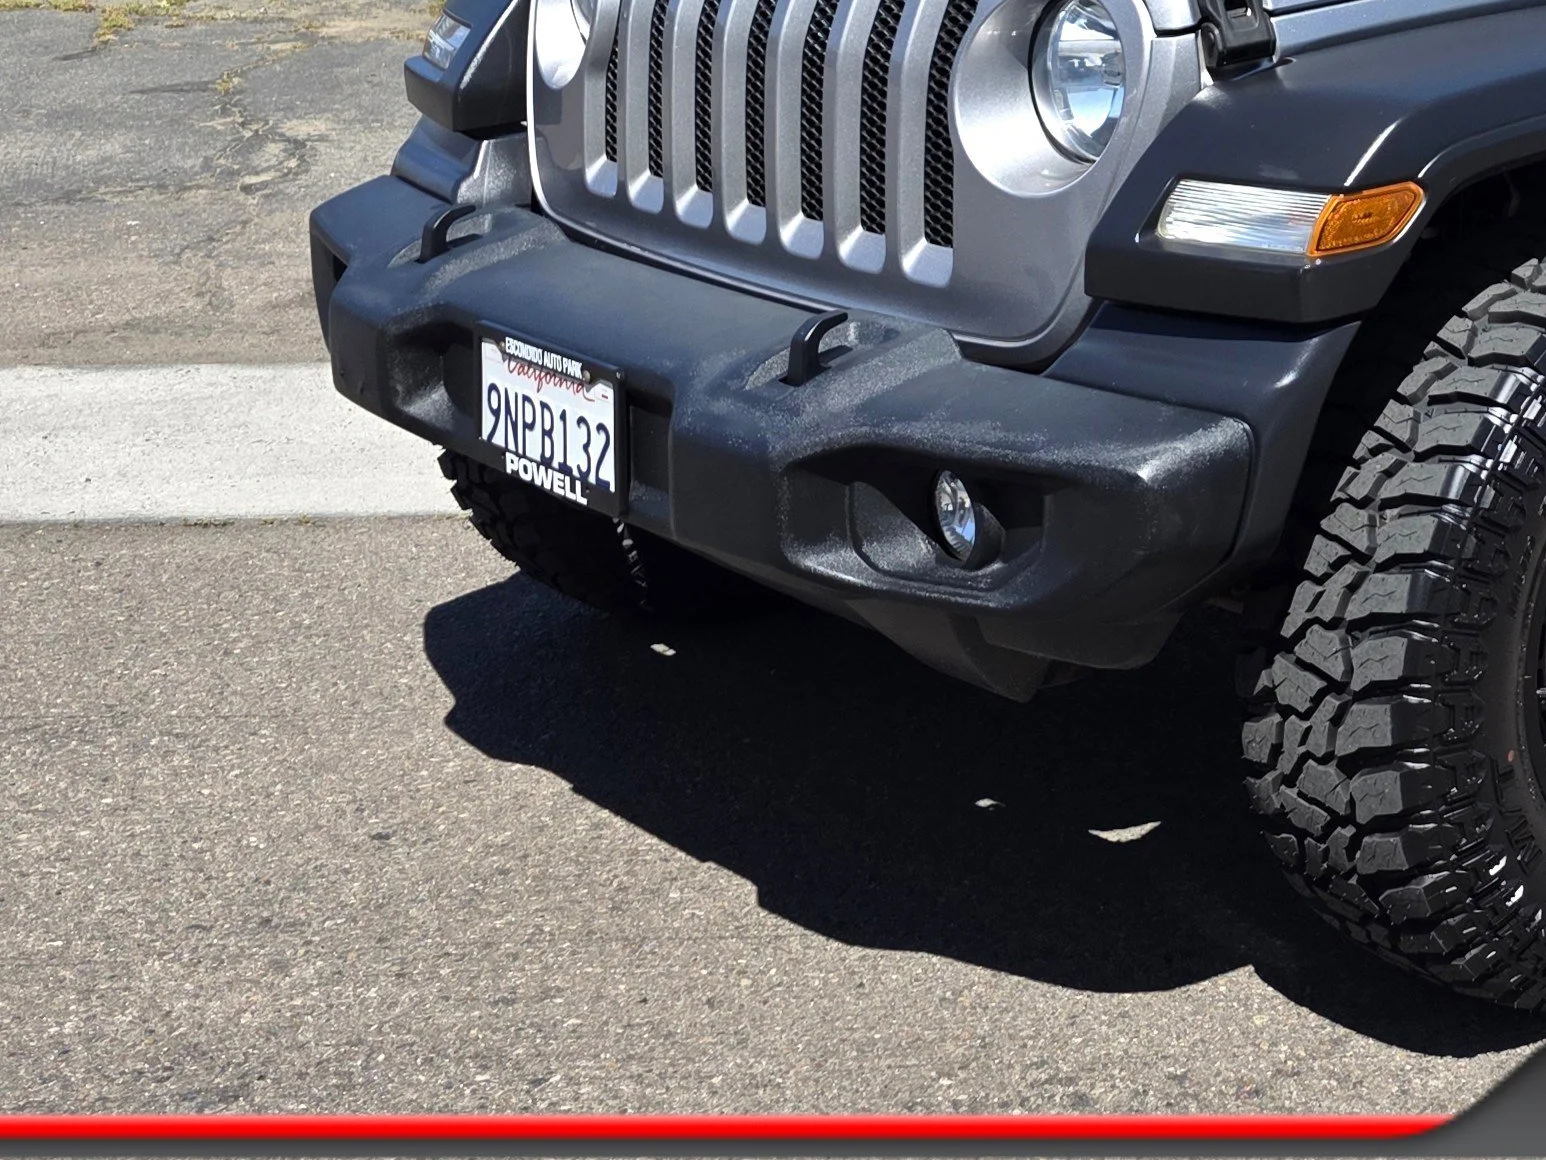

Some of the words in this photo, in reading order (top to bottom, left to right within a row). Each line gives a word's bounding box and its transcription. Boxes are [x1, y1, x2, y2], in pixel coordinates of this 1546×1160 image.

[503, 354, 595, 402] California
[505, 336, 543, 366] ESCONDIDO
[543, 351, 563, 371] AUTO
[562, 356, 583, 379] PARK
[486, 382, 611, 491] 9NPB132
[505, 451, 588, 506] POWELL
